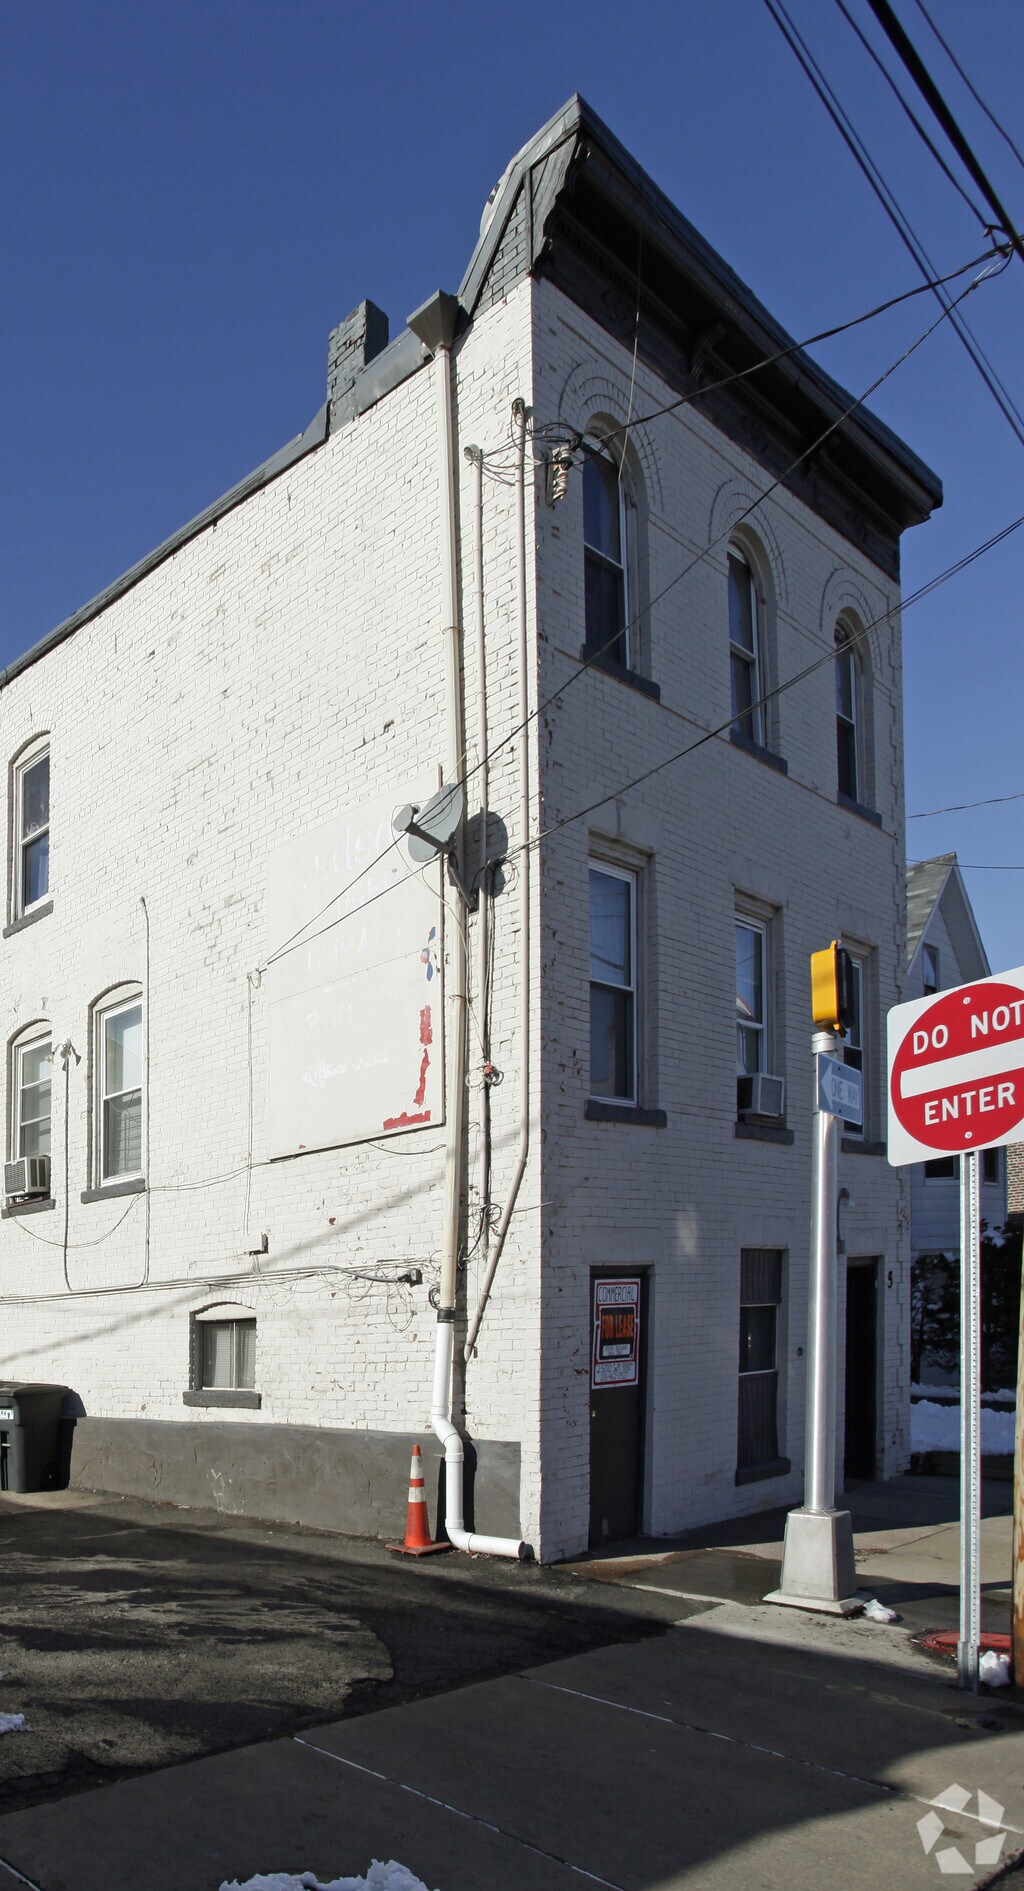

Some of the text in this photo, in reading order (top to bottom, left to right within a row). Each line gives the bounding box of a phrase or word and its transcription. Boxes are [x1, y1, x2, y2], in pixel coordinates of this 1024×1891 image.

[913, 1002, 1024, 1055] DO NOT
[924, 1082, 1016, 1126] ENTER
[887, 1270, 893, 1289] 5
[598, 1286, 635, 1302] COMMERCIAL
[601, 1313, 635, 1339] FOR LEASE
